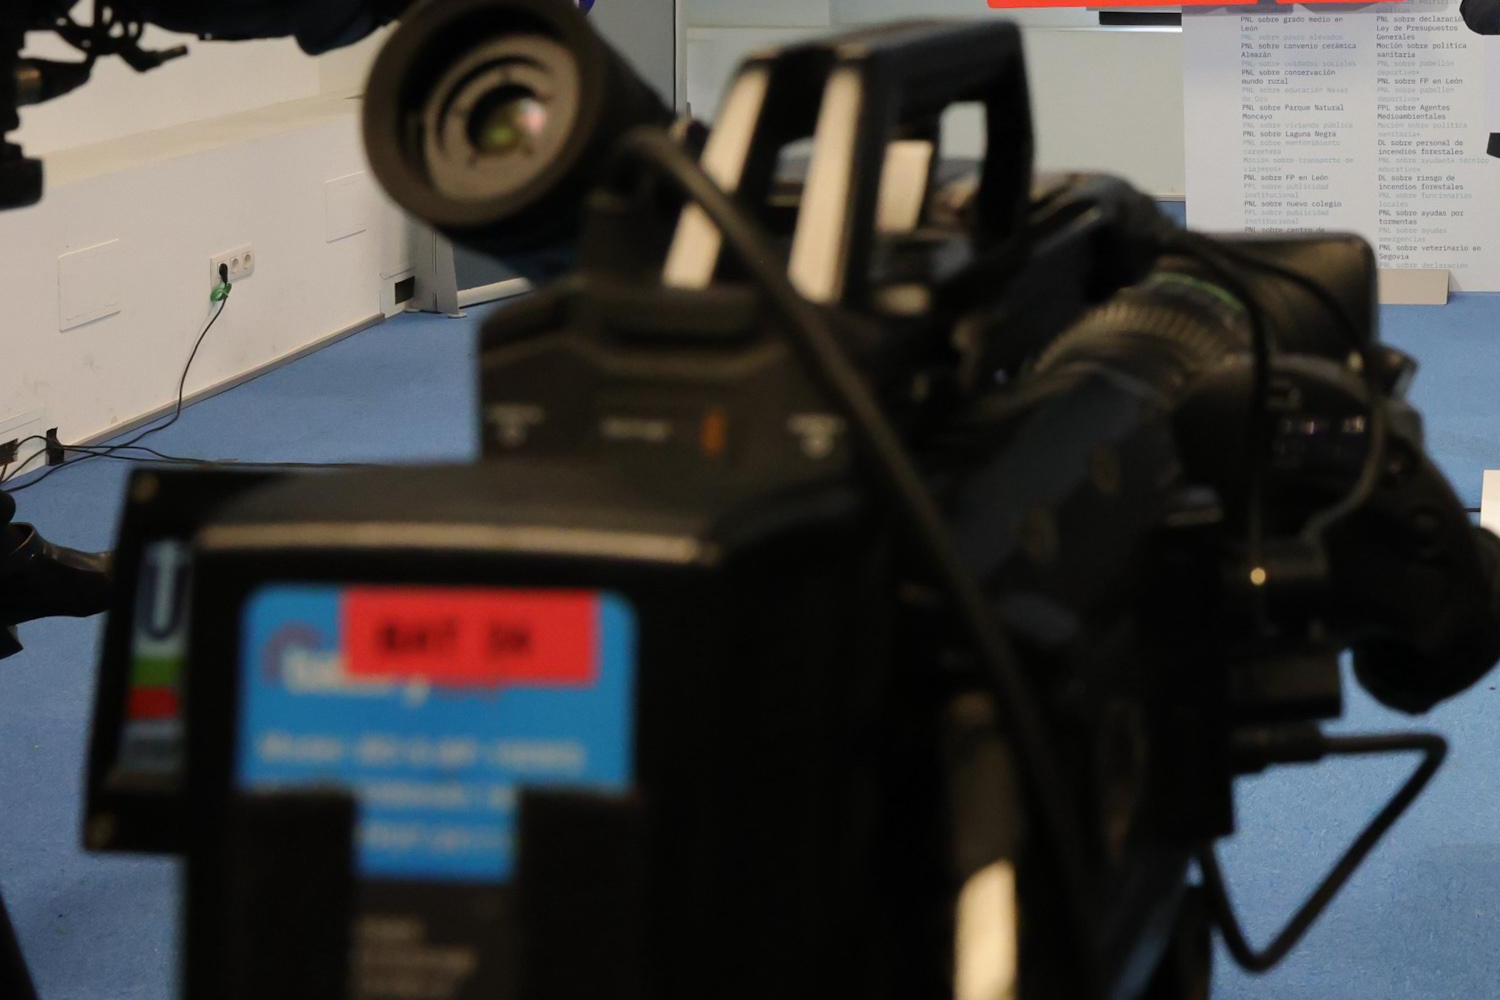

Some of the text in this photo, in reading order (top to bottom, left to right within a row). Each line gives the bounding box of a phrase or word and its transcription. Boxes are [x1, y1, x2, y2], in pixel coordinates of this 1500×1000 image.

[1283, 16, 1305, 24] grado
[1284, 104, 1311, 112] Parque
[1420, 104, 1450, 112] Agentes
[1285, 130, 1311, 138] Laguna
[1314, 130, 1336, 138] Negra
